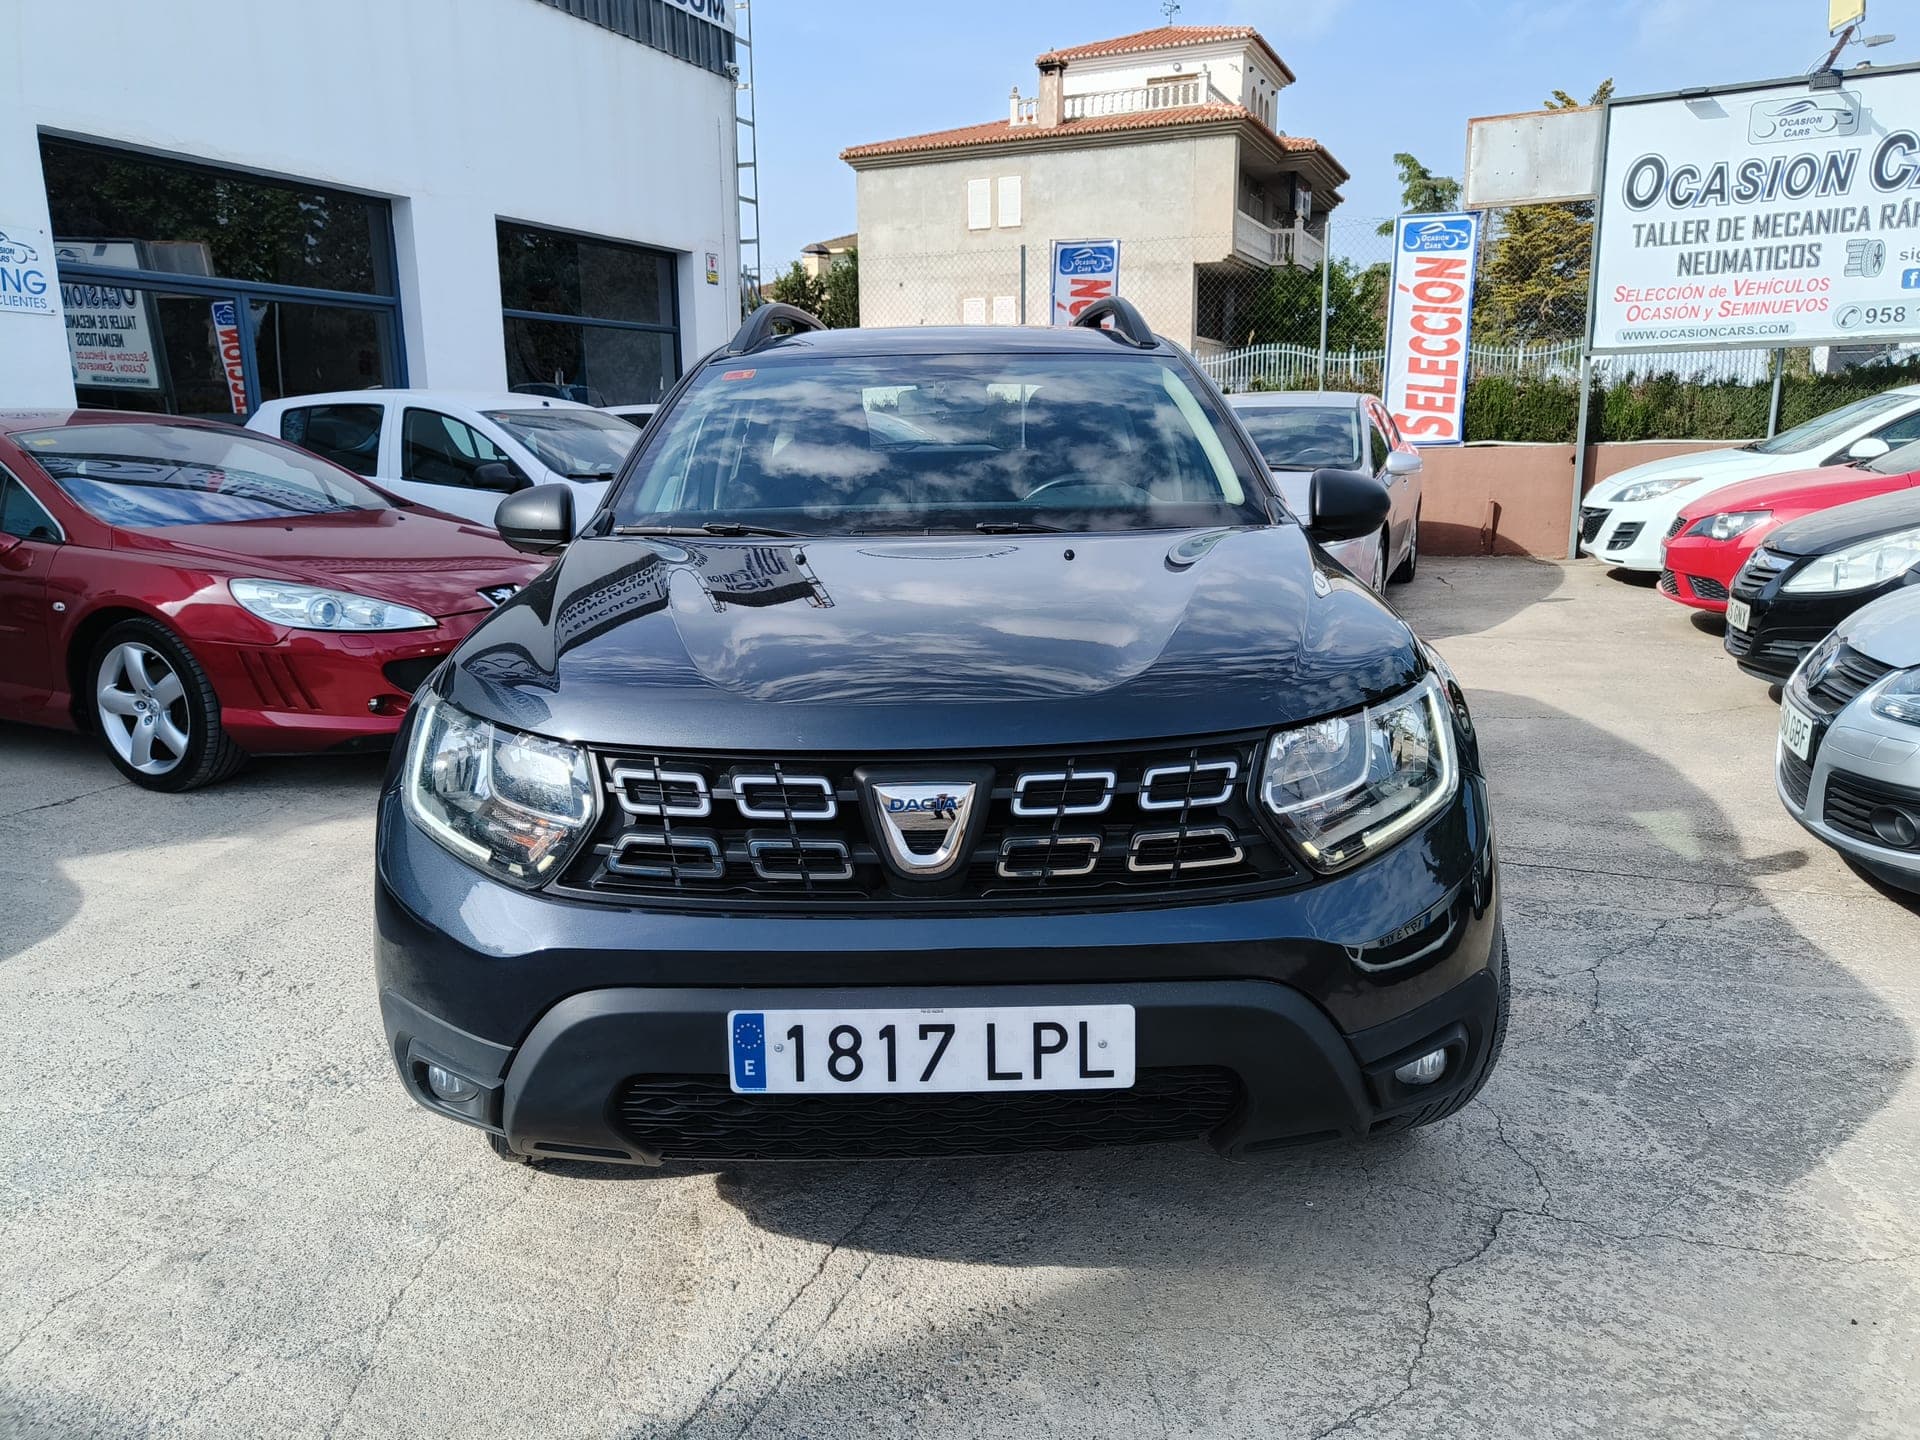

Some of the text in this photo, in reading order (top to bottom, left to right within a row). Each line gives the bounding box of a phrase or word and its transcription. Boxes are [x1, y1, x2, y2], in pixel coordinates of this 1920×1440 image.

[1780, 116, 1823, 127] OCASION
[1784, 128, 1810, 137] CARS
[1622, 129, 1920, 211] OCASION C
[1633, 219, 1710, 248] TALLER
[1717, 216, 1746, 242] DE
[1752, 206, 1871, 239] MECANICA
[1677, 243, 1822, 276] NEUMATICOS
[1614, 277, 1831, 303] SELECCIÓN de VEHÍCULOS
[1626, 298, 1829, 322] OCASIÓN y SEMINUEVOS
[1865, 306, 1906, 325] 958
[1622, 324, 1789, 341] WWW.OCASIONCARS.COM
[1393, 256, 1467, 437] SELECCIÓN
[1790, 715, 1809, 749] GBF
[889, 798, 957, 811] DACIA
[787, 1021, 1115, 1082] 1817 LPL
[745, 1060, 755, 1075] E
